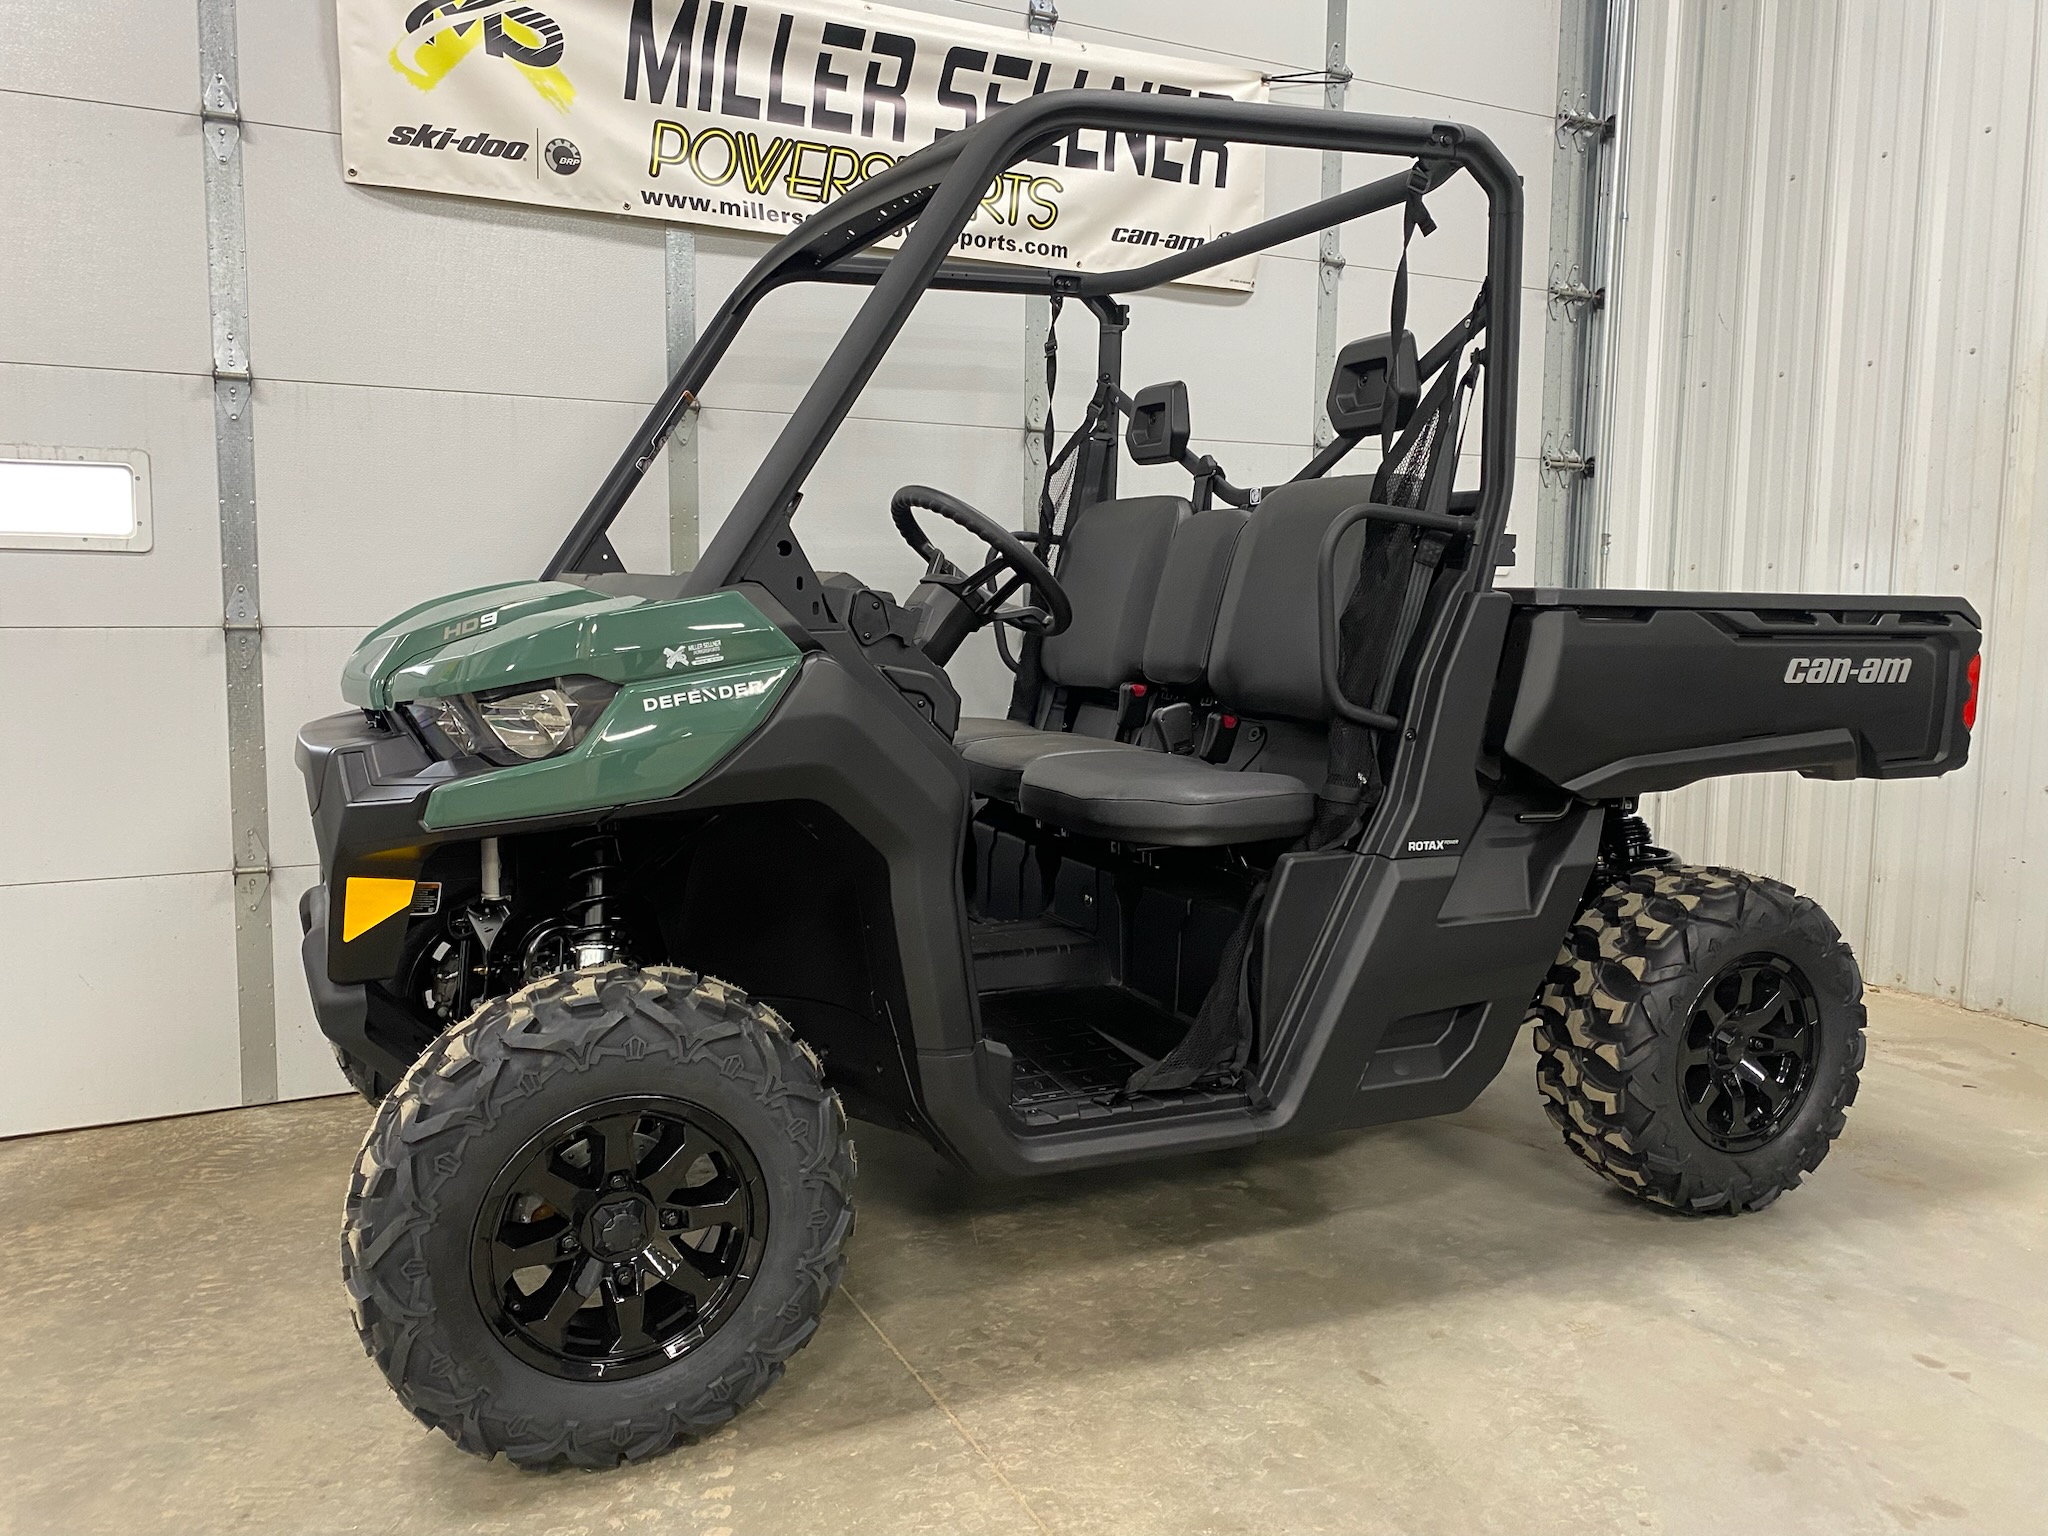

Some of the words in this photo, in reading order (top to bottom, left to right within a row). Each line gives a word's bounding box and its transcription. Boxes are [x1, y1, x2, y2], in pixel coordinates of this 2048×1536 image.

[623, 0, 917, 142] MILLER
[559, 157, 580, 166] BRP
[443, 611, 498, 640] HD9
[1784, 658, 1912, 684] can-am
[642, 680, 765, 712] DEFENDER
[1408, 840, 1444, 852] ROTAX
